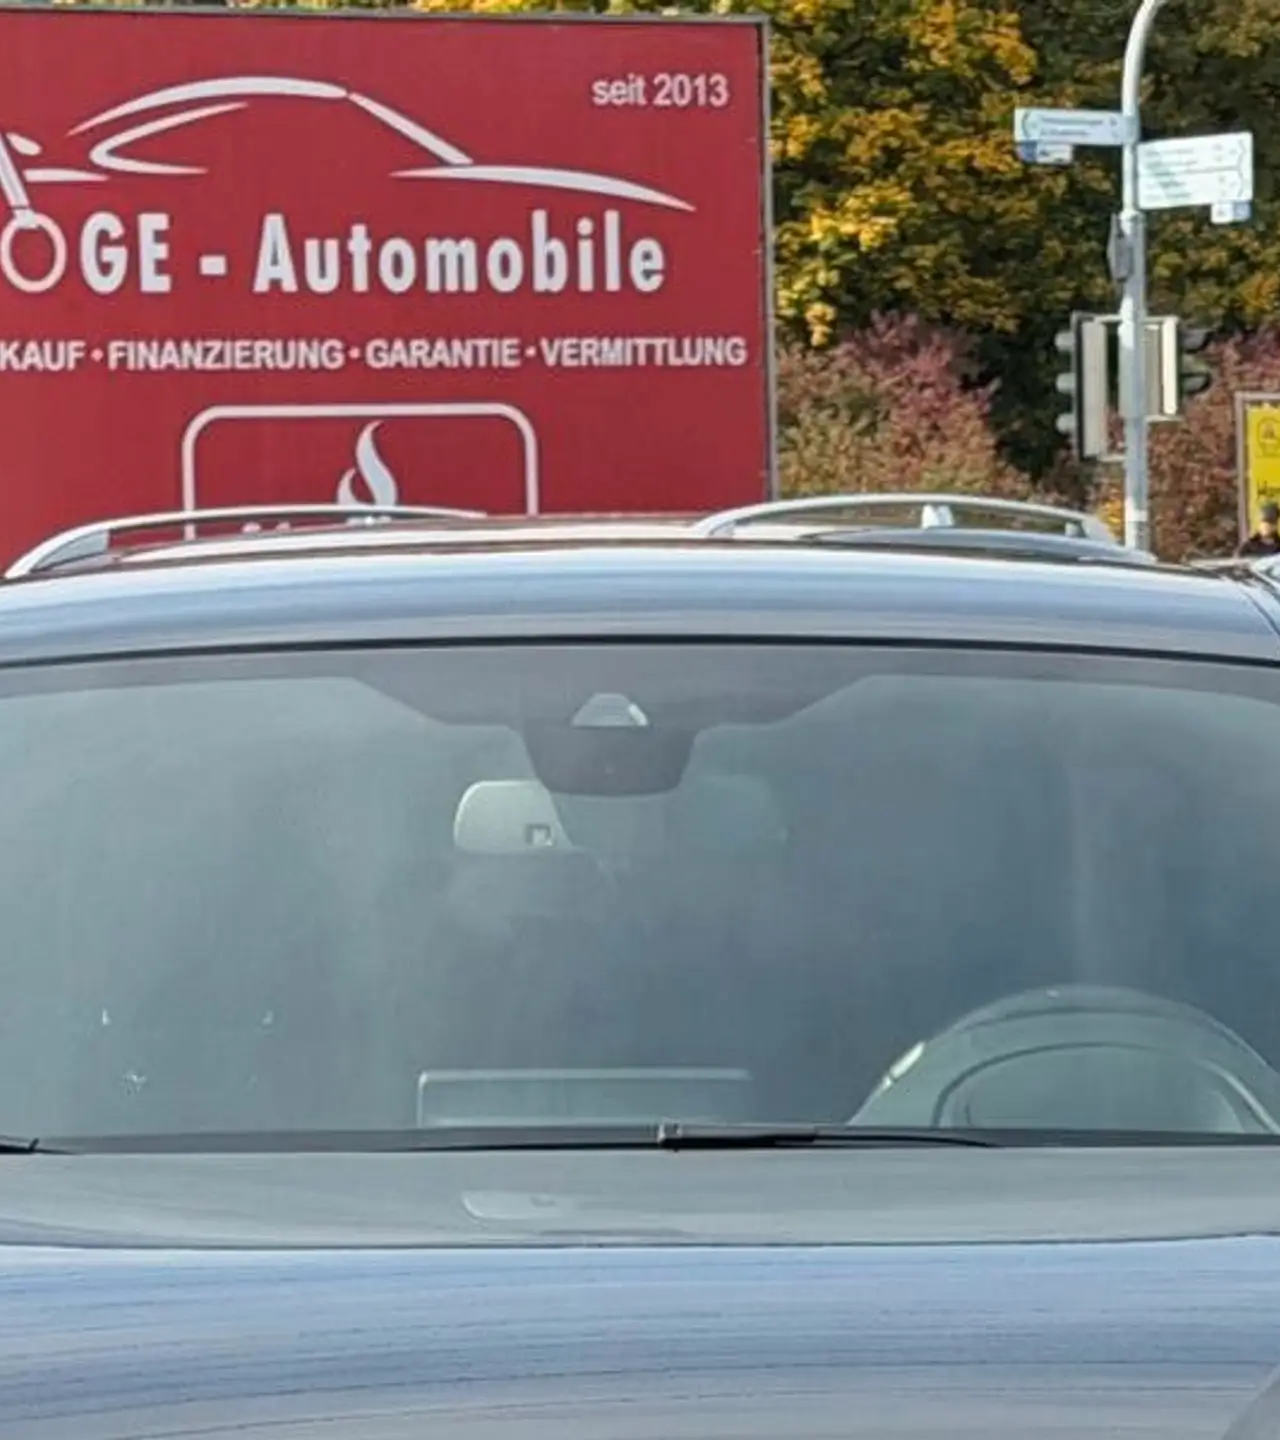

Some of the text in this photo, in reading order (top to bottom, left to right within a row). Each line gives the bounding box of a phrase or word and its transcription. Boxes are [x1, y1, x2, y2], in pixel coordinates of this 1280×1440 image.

[591, 73, 729, 107] seit 2013
[252, 209, 665, 294] Automobile
[107, 339, 345, 370] FINANZIERUNG
[365, 338, 520, 368] GARANTIE
[541, 337, 748, 367] VERMITTLUNG
